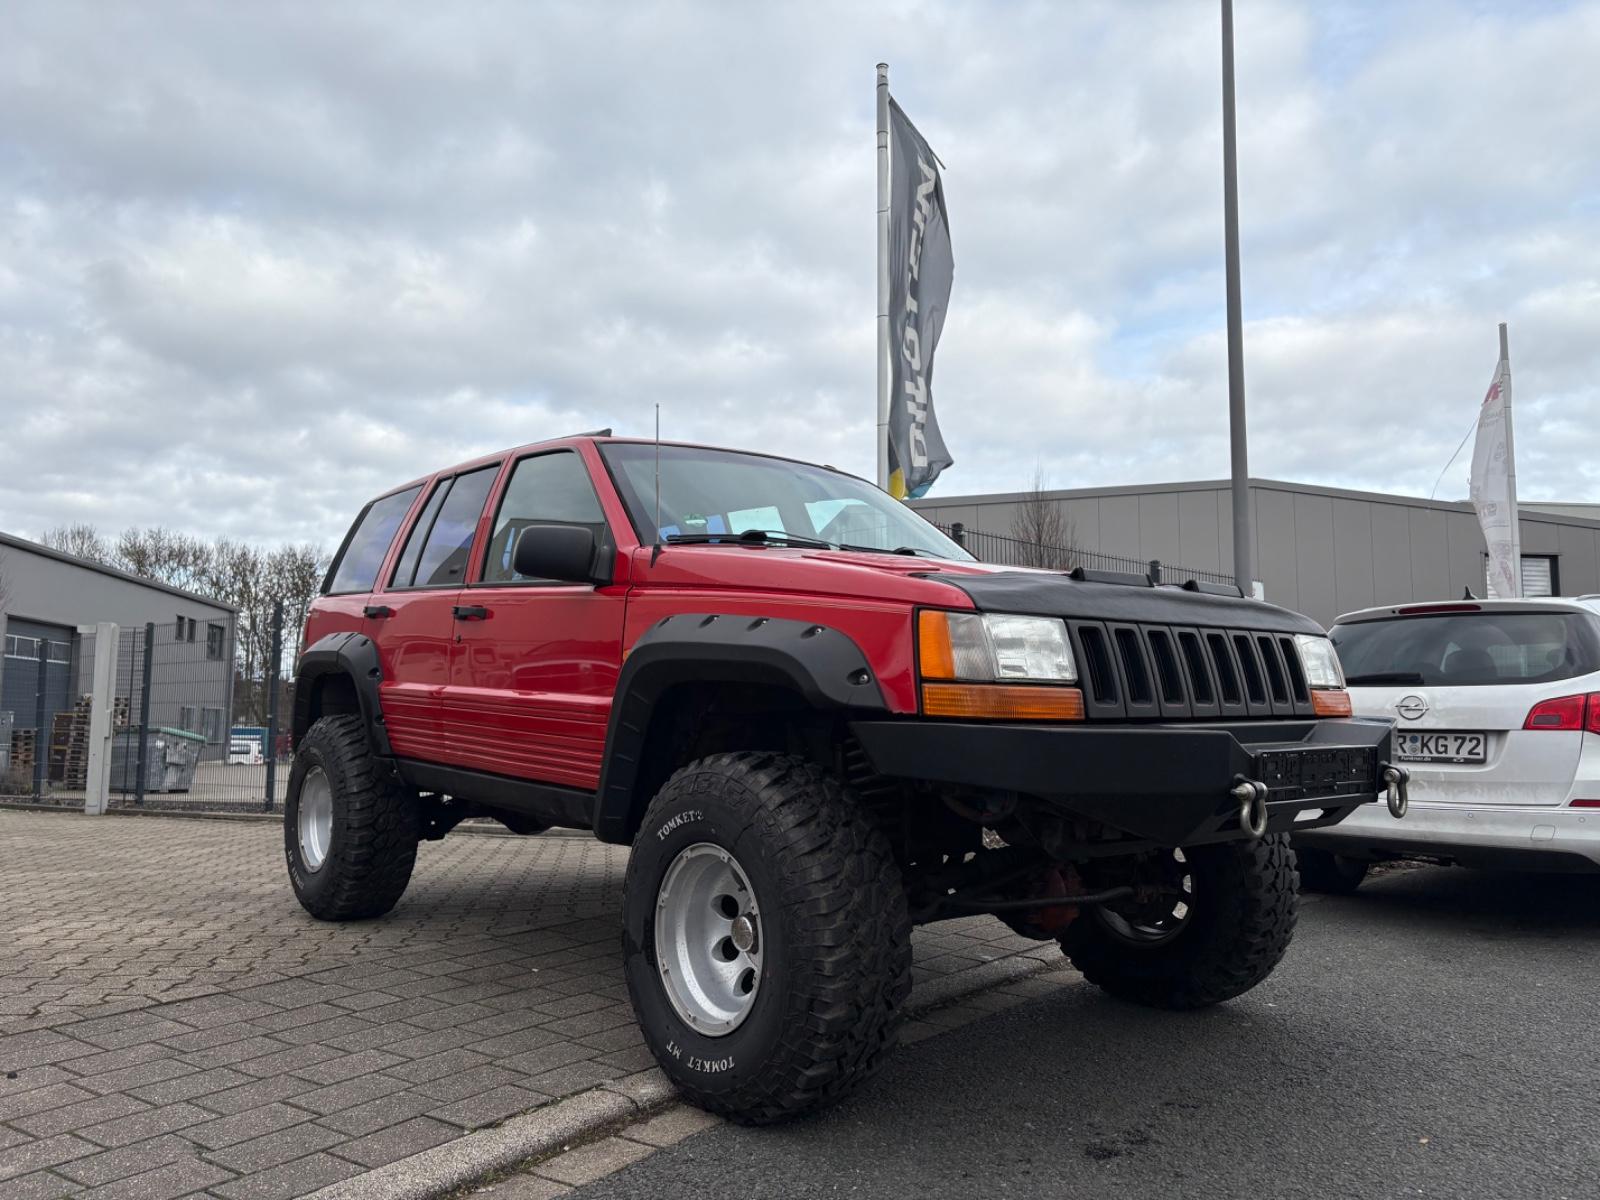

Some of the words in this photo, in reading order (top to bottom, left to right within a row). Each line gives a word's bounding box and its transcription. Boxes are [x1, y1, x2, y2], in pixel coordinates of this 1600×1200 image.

[1420, 735, 1448, 754] KG
[1453, 736, 1481, 756] 72
[656, 810, 695, 841] TOMKET
[666, 1040, 682, 1060] MT
[687, 1055, 735, 1073] TOMKET
